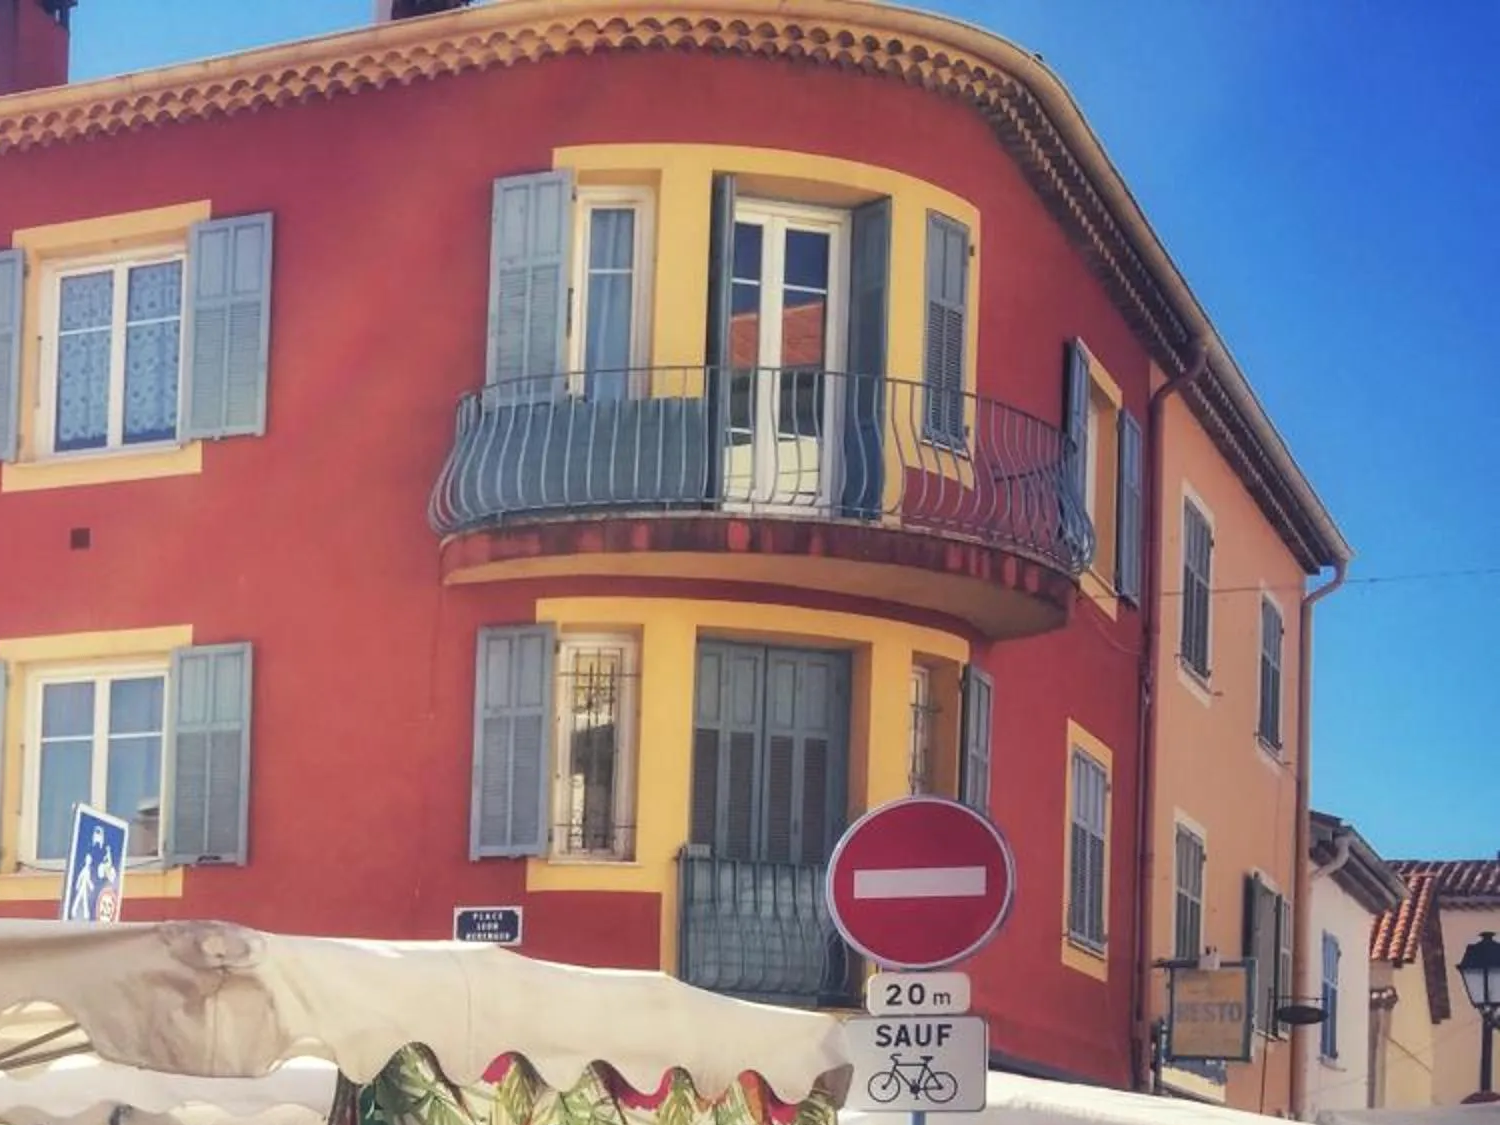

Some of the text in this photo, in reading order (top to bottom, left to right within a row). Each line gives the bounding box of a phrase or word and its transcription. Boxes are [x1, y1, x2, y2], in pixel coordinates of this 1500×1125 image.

[885, 983, 951, 1006] 20 m
[875, 1023, 953, 1048] SAUF
